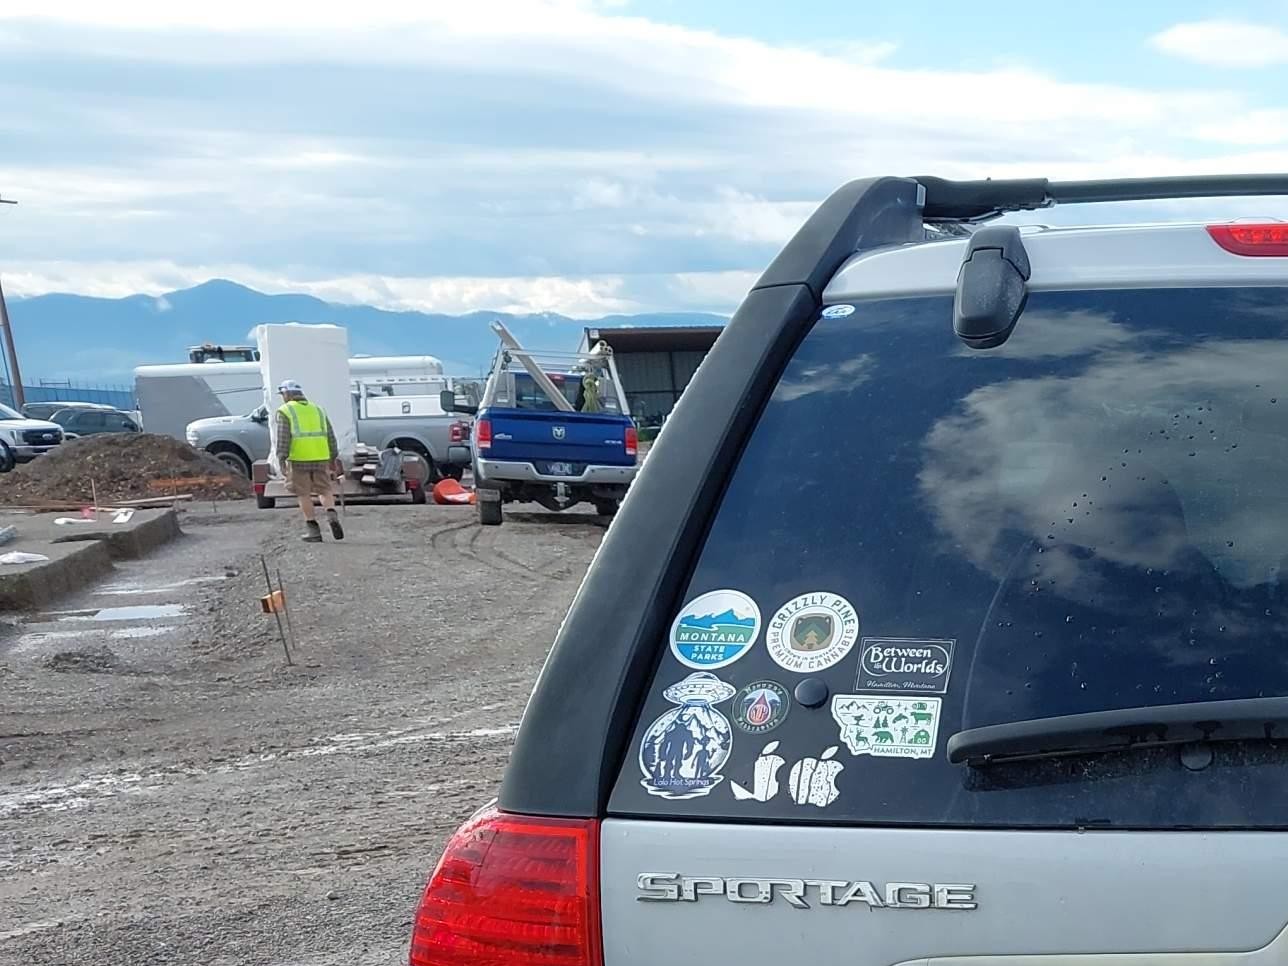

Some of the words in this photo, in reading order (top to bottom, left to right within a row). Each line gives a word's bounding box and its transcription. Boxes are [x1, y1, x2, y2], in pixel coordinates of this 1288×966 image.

[772, 594, 828, 630] GRIZZLY
[831, 599, 856, 626] PINE
[680, 632, 745, 642] MONTANA
[770, 631, 803, 669] PREMIUM
[808, 628, 854, 669] CANNABIS
[870, 646, 932, 663] Between
[882, 657, 944, 674] Worlds
[873, 746, 919, 756] HAMILTON,
[920, 748, 932, 756] MT
[636, 871, 978, 909] SPORTAGE
